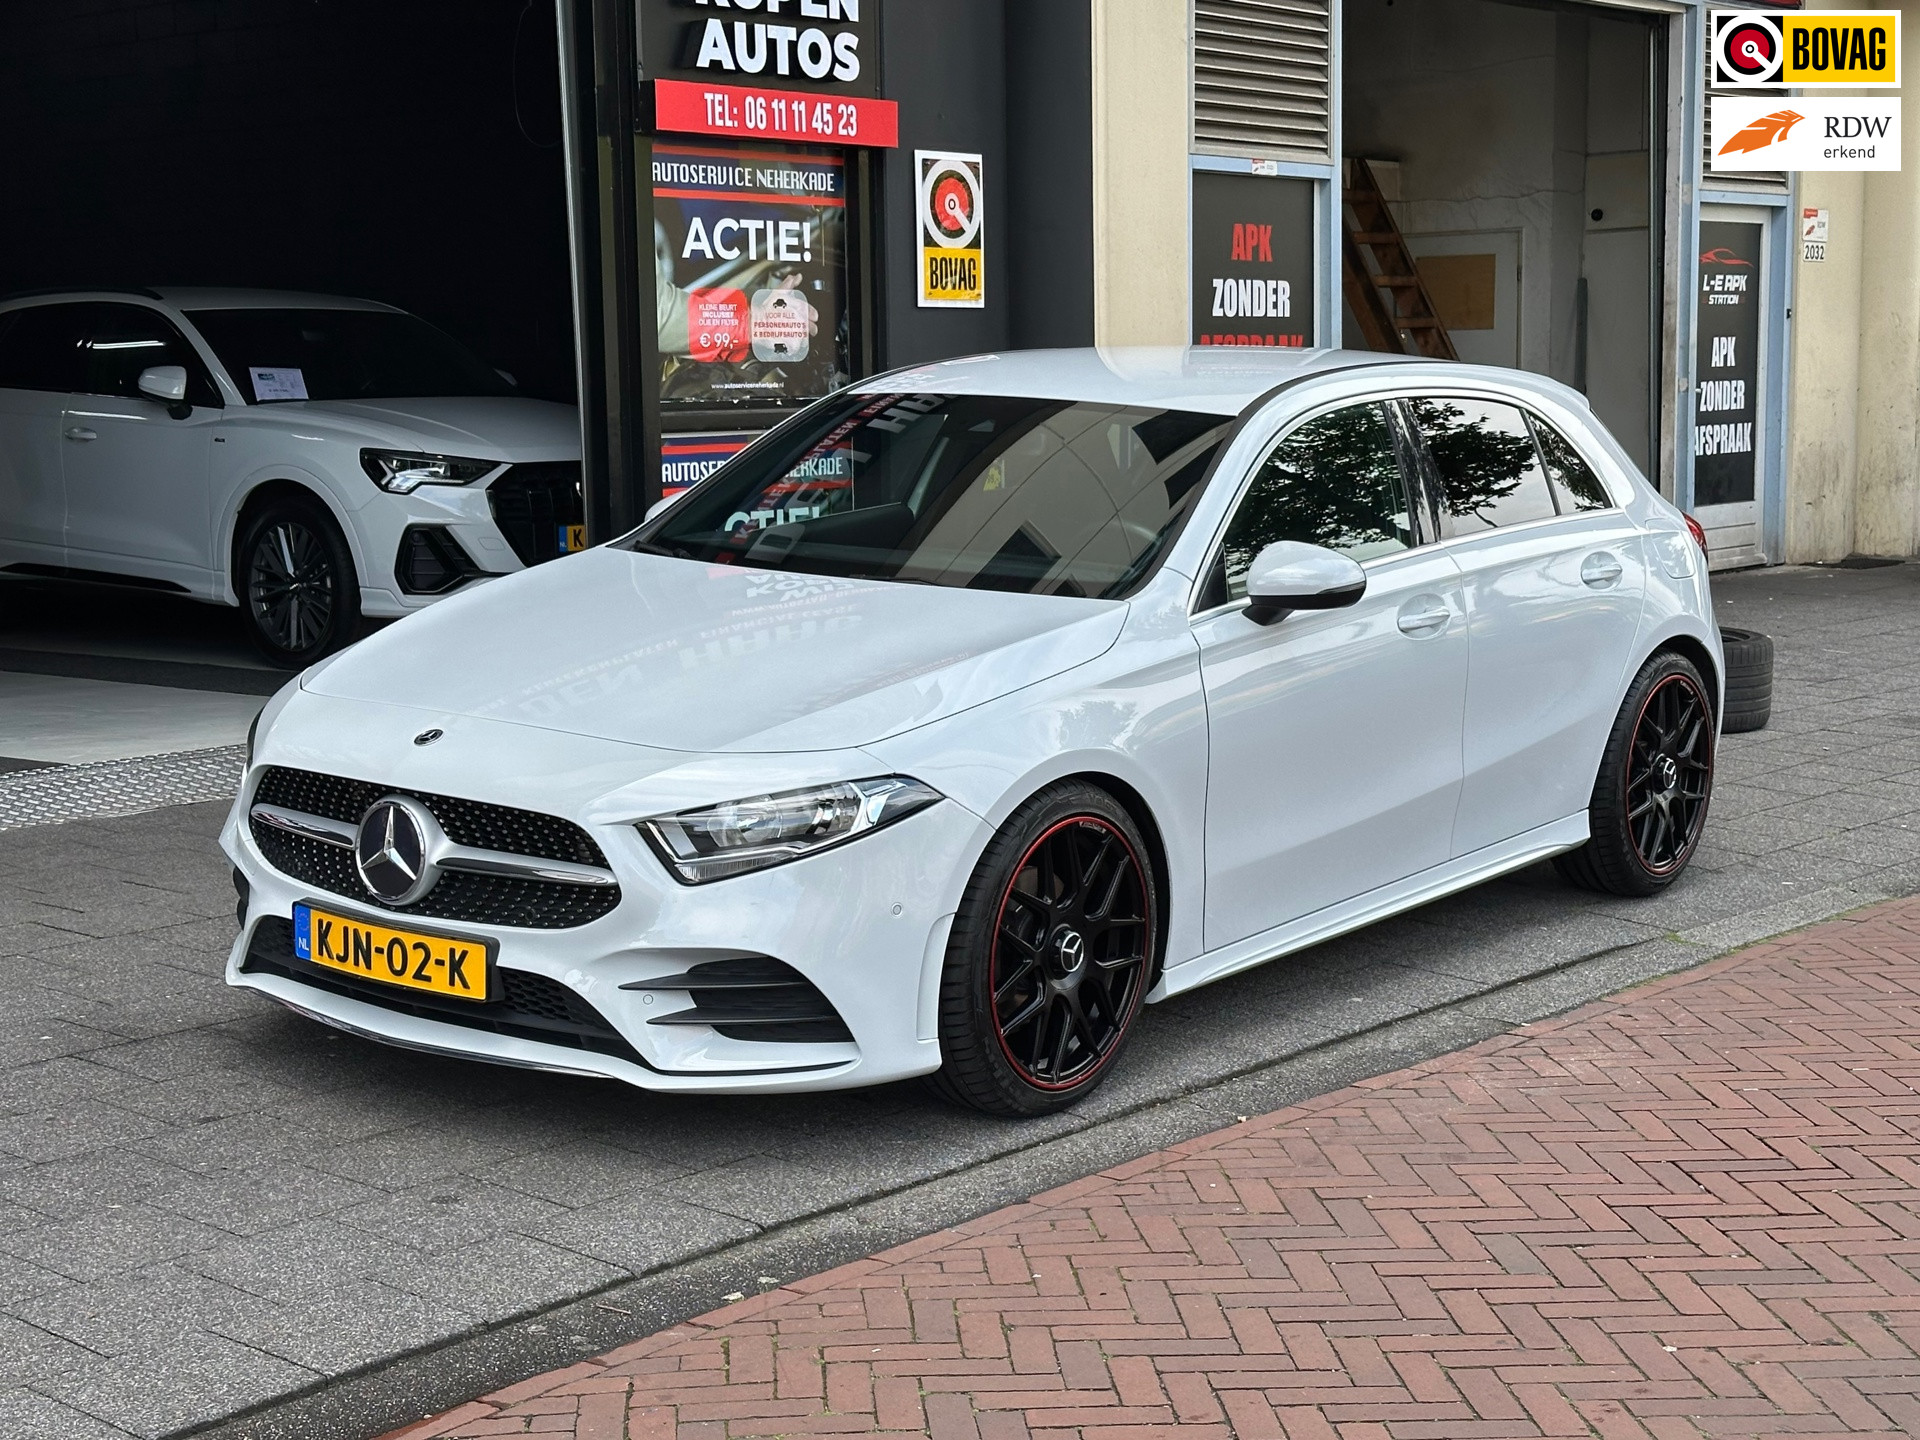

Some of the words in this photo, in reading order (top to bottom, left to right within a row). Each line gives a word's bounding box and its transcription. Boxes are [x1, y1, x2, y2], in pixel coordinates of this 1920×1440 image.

[696, 18, 860, 82] AUTOS
[704, 92, 739, 128] TEL:
[745, 95, 767, 130] 06
[771, 98, 787, 131] 11
[791, 100, 807, 133] 11
[811, 102, 833, 135] 45
[838, 104, 857, 137] 23
[652, 162, 753, 187] AUTOSERVICE
[756, 168, 835, 191] NEHERKADE
[682, 217, 812, 263] ACTIE!
[1230, 223, 1273, 263] APK
[1804, 245, 1825, 260] 2032
[930, 256, 977, 291] BOVAG
[1212, 279, 1291, 318] ZONDER
[1708, 294, 1740, 305] STATION
[699, 333, 711, 347] €
[1711, 336, 1736, 367] APK
[1700, 380, 1745, 412] ZONDER
[1694, 423, 1752, 457] AFSPRAAK
[298, 937, 310, 951] NL
[317, 918, 471, 990] KJN-02-K
